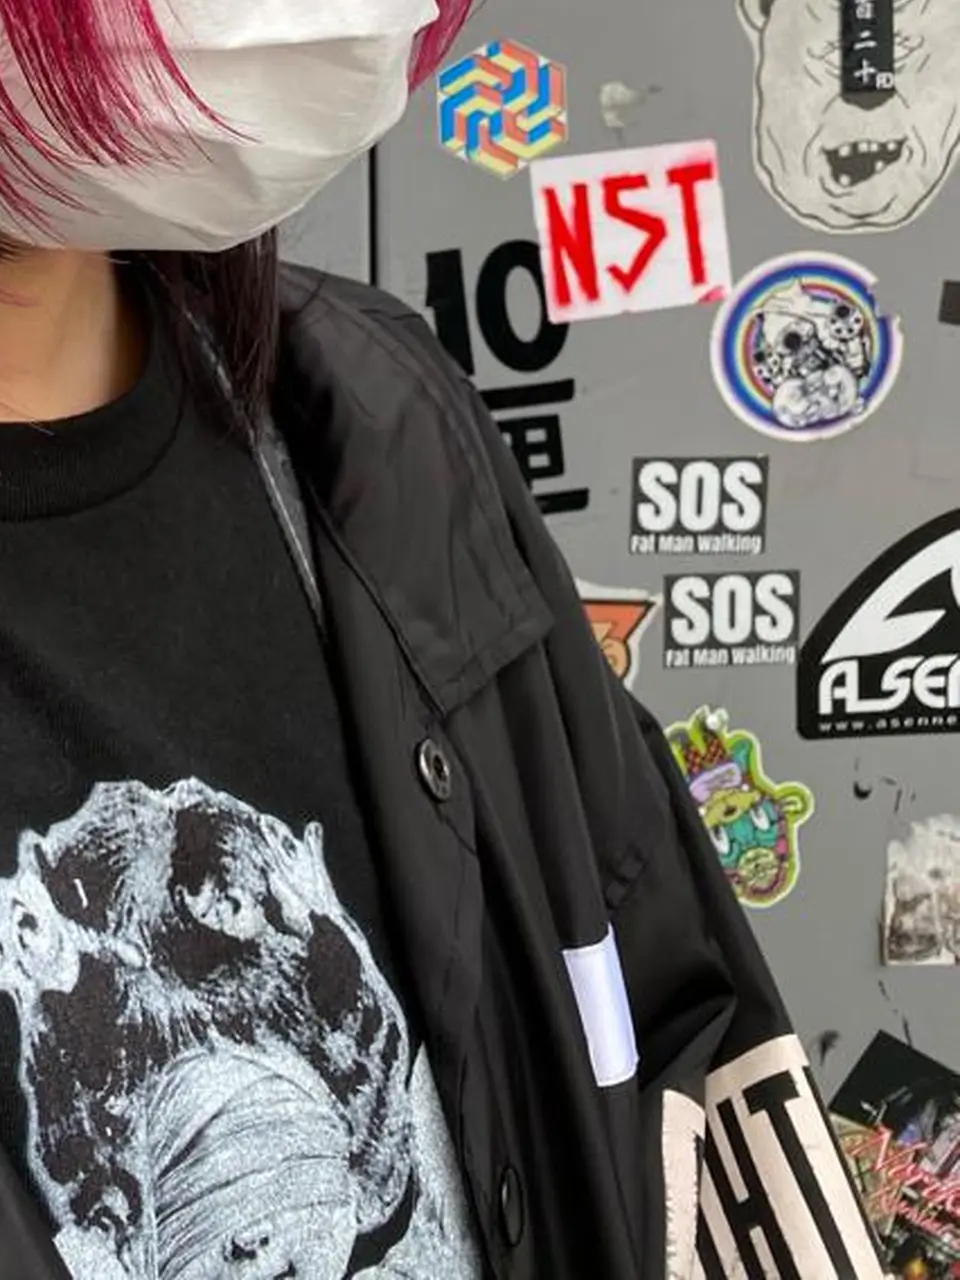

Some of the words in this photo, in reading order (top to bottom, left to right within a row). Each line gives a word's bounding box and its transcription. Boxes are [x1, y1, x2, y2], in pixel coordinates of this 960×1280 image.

[543, 160, 714, 309] NST
[425, 239, 569, 374] 10
[637, 460, 763, 532] SOS
[658, 534, 695, 552] Man
[670, 573, 795, 646] SOS
[692, 648, 730, 666] Man
